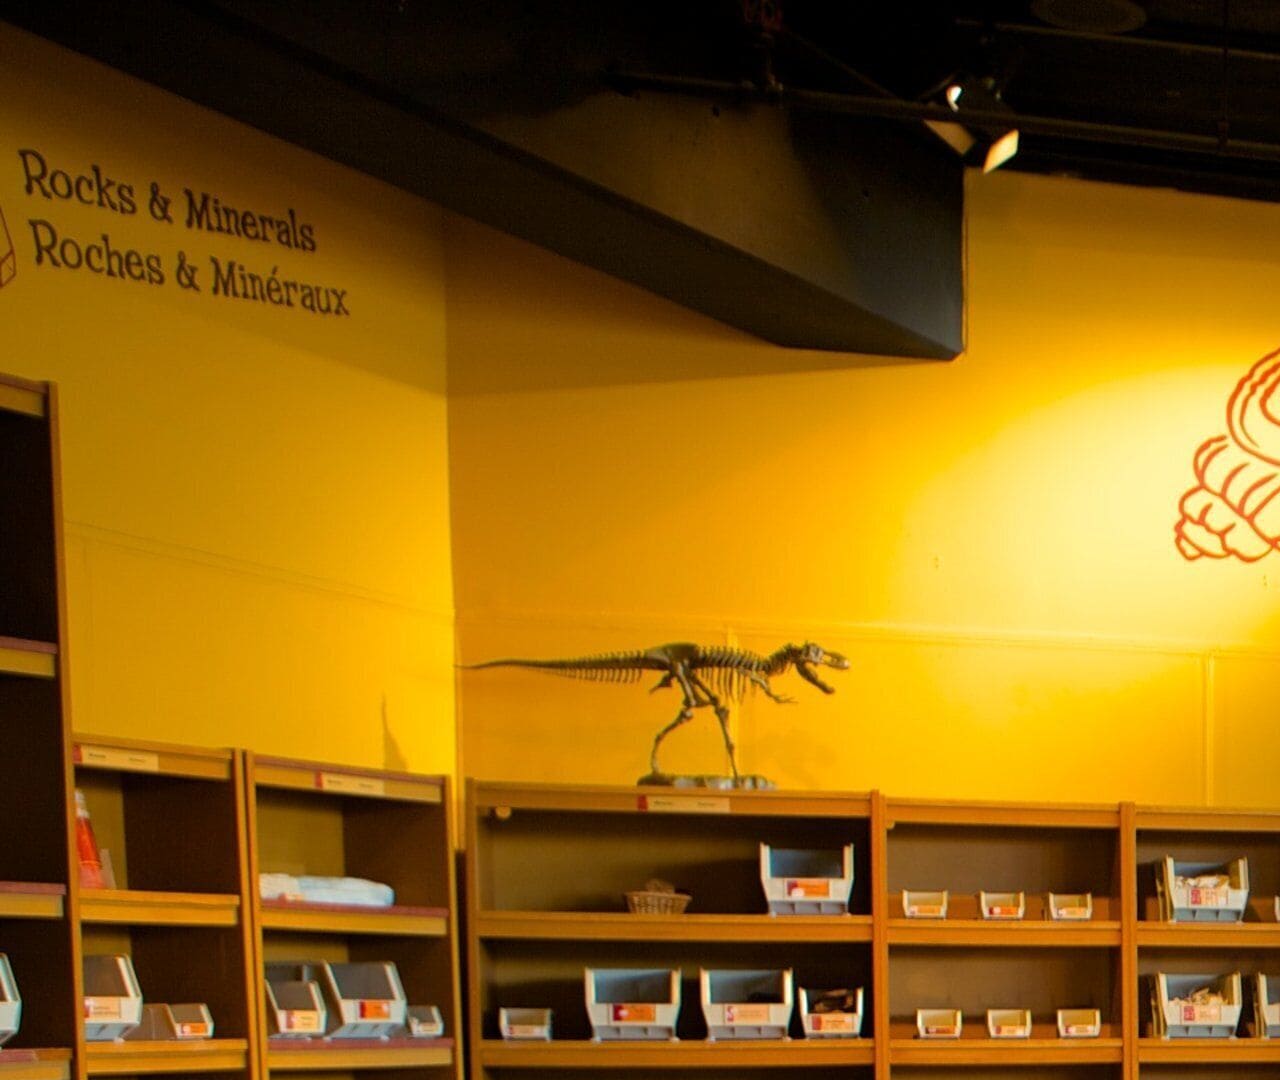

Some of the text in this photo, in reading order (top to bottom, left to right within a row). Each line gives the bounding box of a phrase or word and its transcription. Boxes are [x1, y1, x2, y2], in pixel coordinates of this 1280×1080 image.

[18, 148, 317, 253] Rocks & Minerals
[28, 219, 350, 317] Roches & Minéraux
